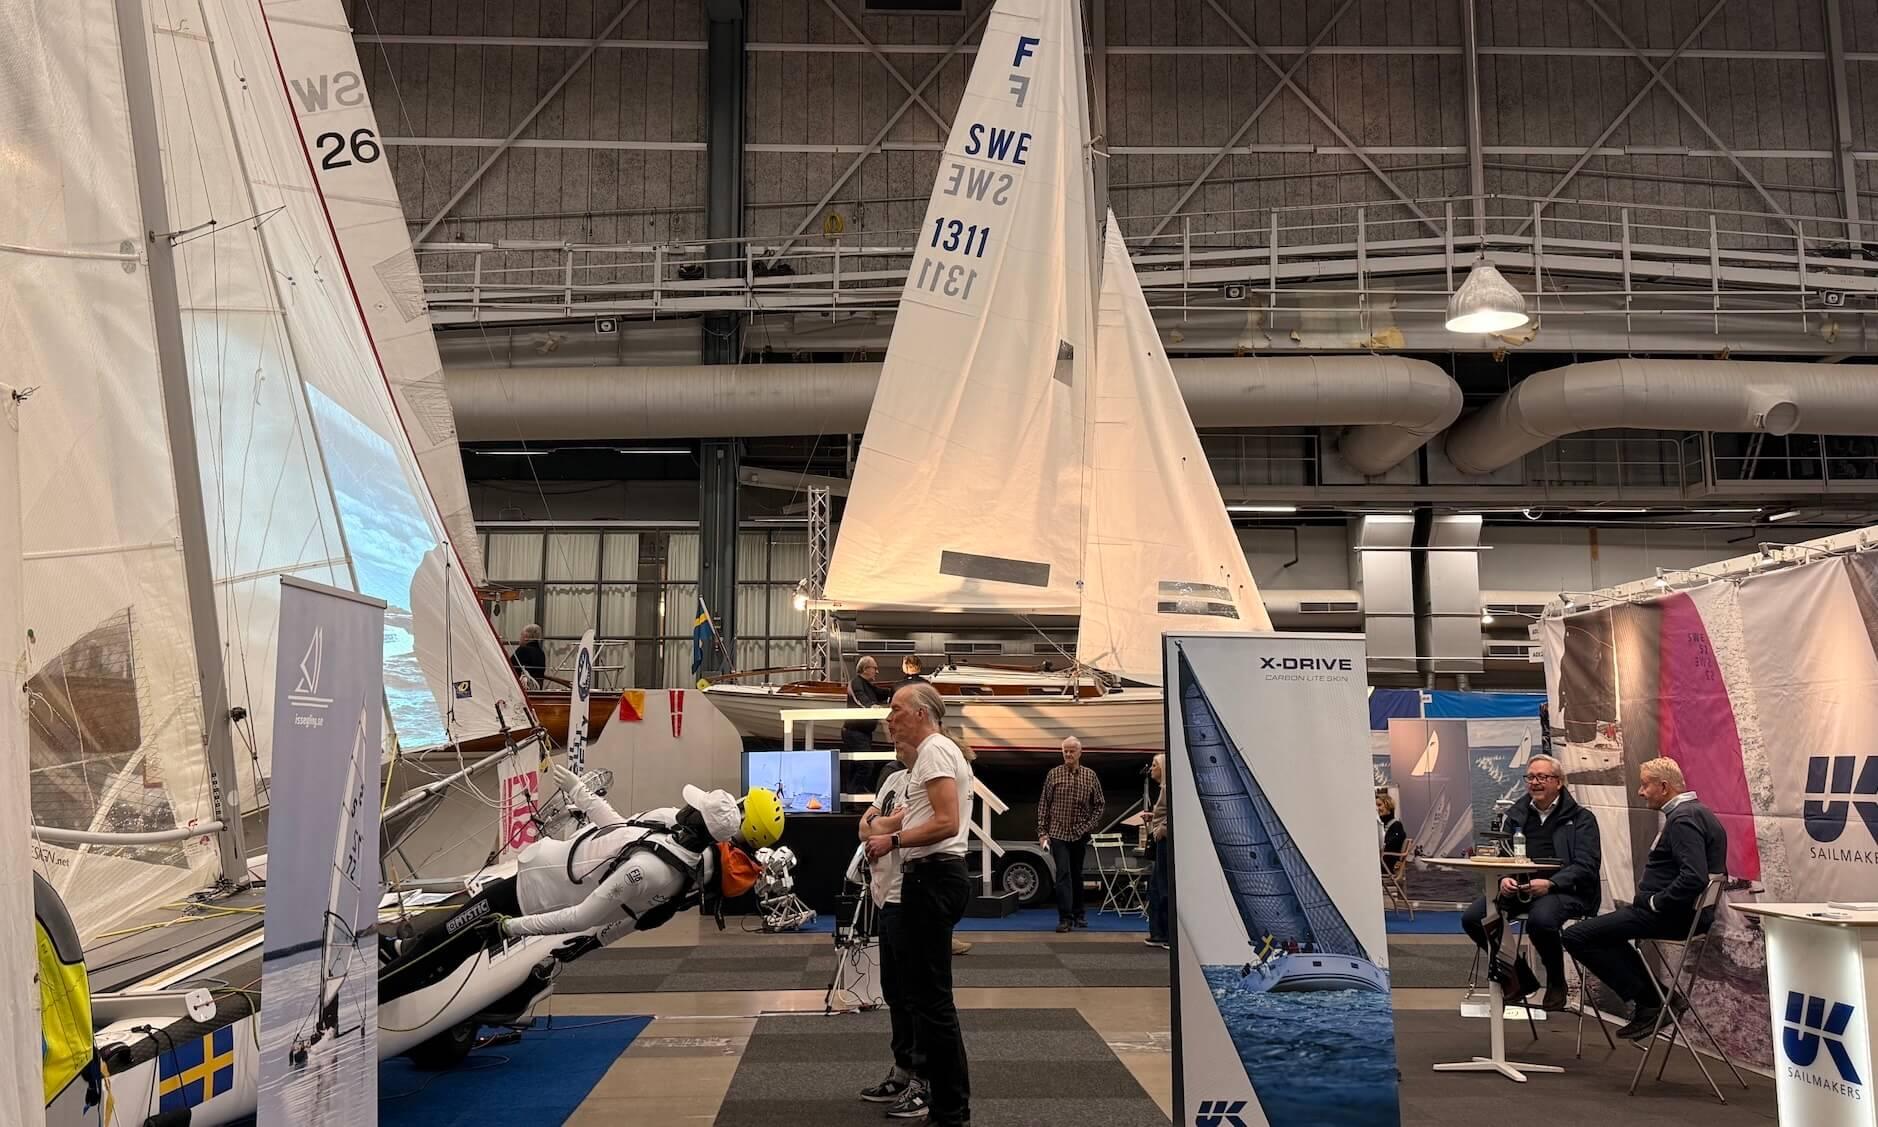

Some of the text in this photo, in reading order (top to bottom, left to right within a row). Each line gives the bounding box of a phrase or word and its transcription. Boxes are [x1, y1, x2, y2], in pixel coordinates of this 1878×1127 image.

[1012, 36, 1040, 67] F
[316, 128, 380, 170] 26
[965, 123, 1032, 165] SWE
[931, 217, 990, 258] 1311
[1260, 657, 1352, 671] X-DRIVE
[1265, 674, 1305, 682] CARBON
[454, 901, 488, 927] MYSTIC
[1782, 990, 1863, 1086] UK
[1787, 1066, 1861, 1100] SAILMAKERS
